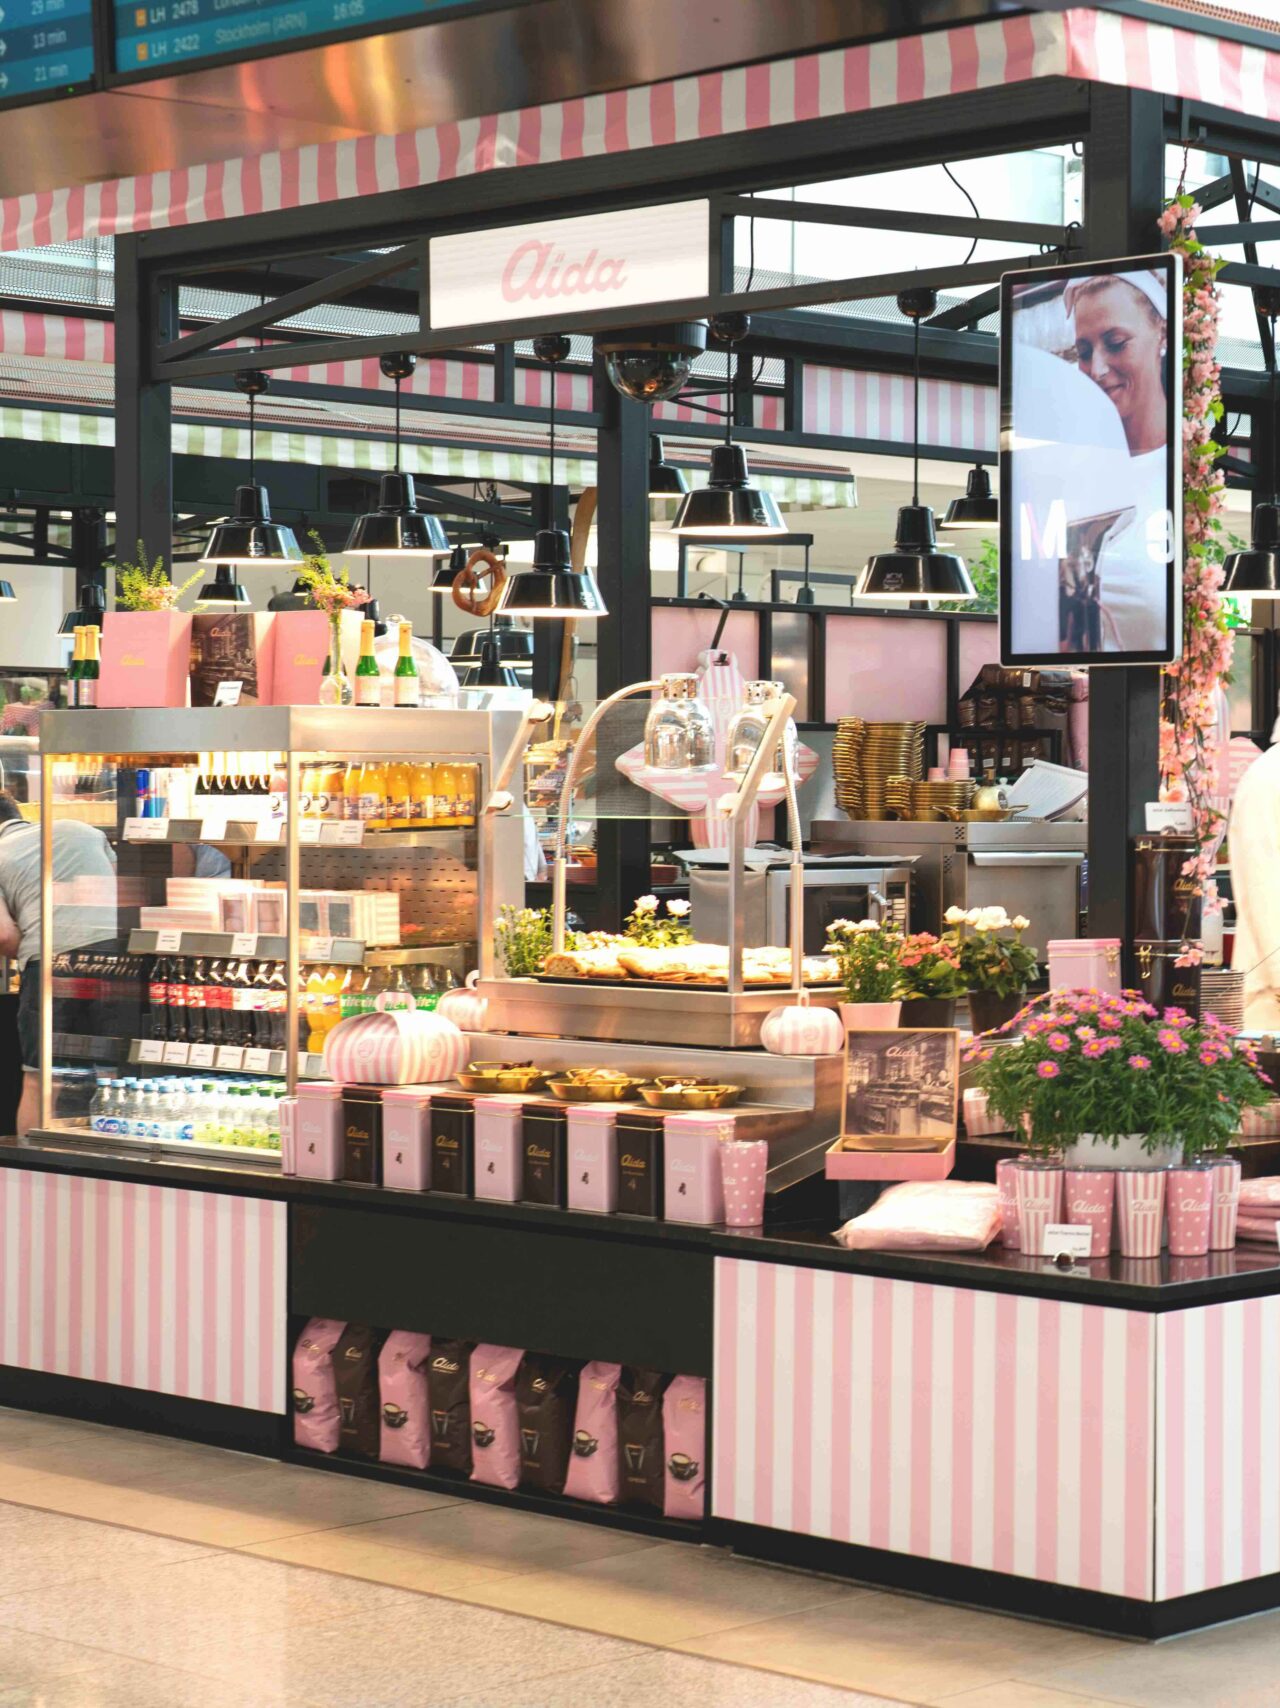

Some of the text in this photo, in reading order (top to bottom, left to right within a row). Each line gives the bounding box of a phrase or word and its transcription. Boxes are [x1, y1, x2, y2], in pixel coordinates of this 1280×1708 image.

[150, 7, 166, 24] LH
[47, 30, 67, 45] min
[152, 41, 167, 58] LH
